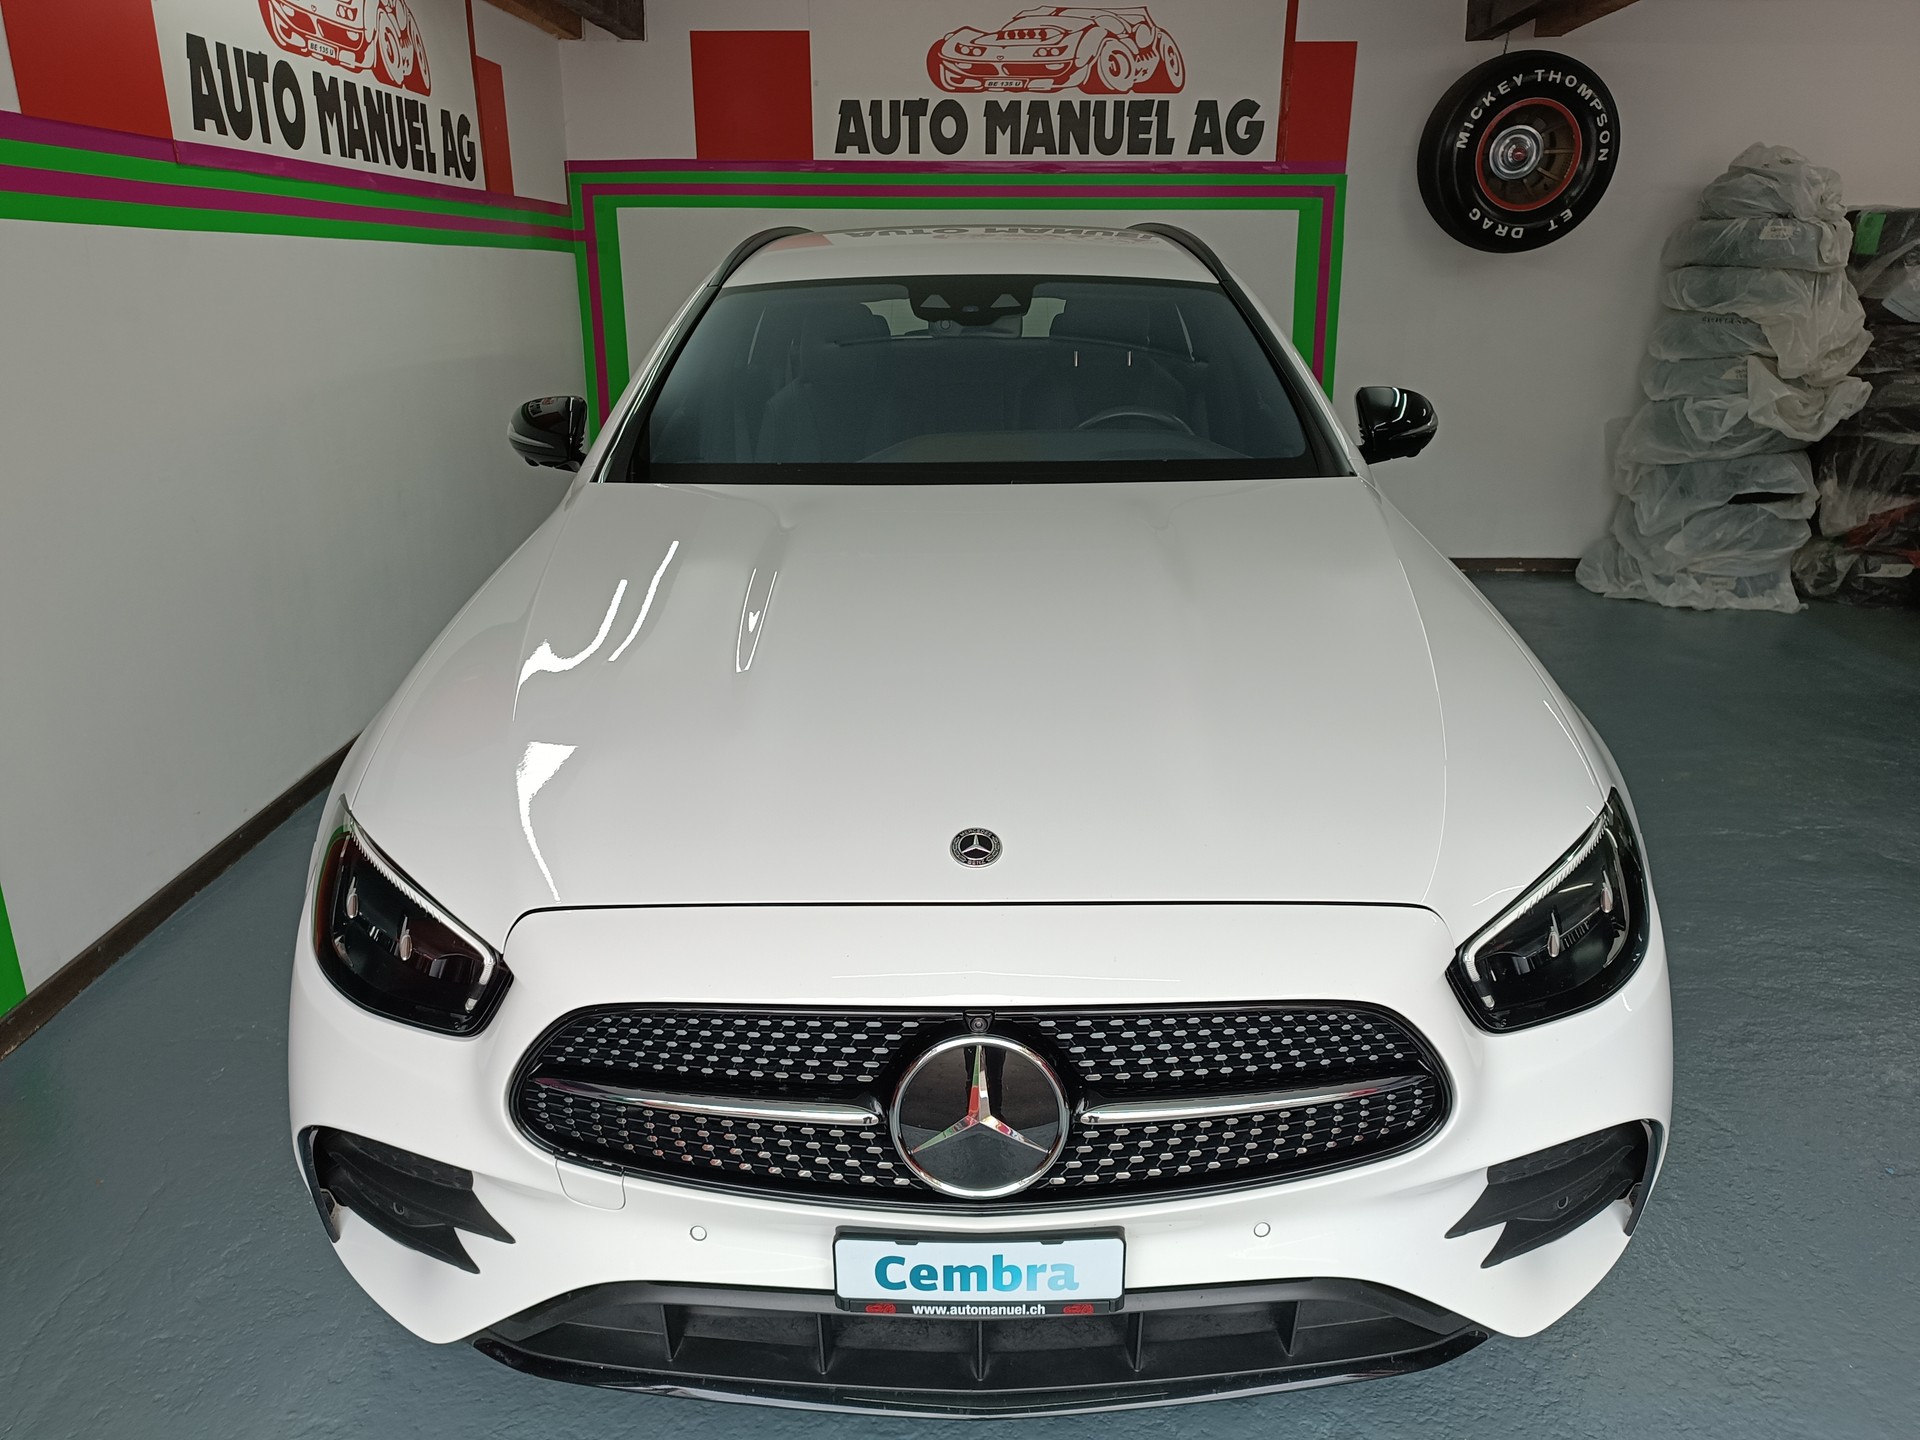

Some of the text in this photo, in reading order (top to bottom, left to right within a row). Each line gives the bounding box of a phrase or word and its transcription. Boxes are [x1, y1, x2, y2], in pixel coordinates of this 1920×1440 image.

[319, 45, 329, 54] 135
[185, 32, 477, 182] AUTO MANUEL AG
[1456, 69, 1611, 162] MICKEY THOMPSON
[834, 98, 1265, 156] AUTO MANUEL AG
[1468, 207, 1574, 239] ET DRAG
[874, 1254, 1080, 1292] Cembra
[912, 1304, 1046, 1316] www.automanuel.ch
